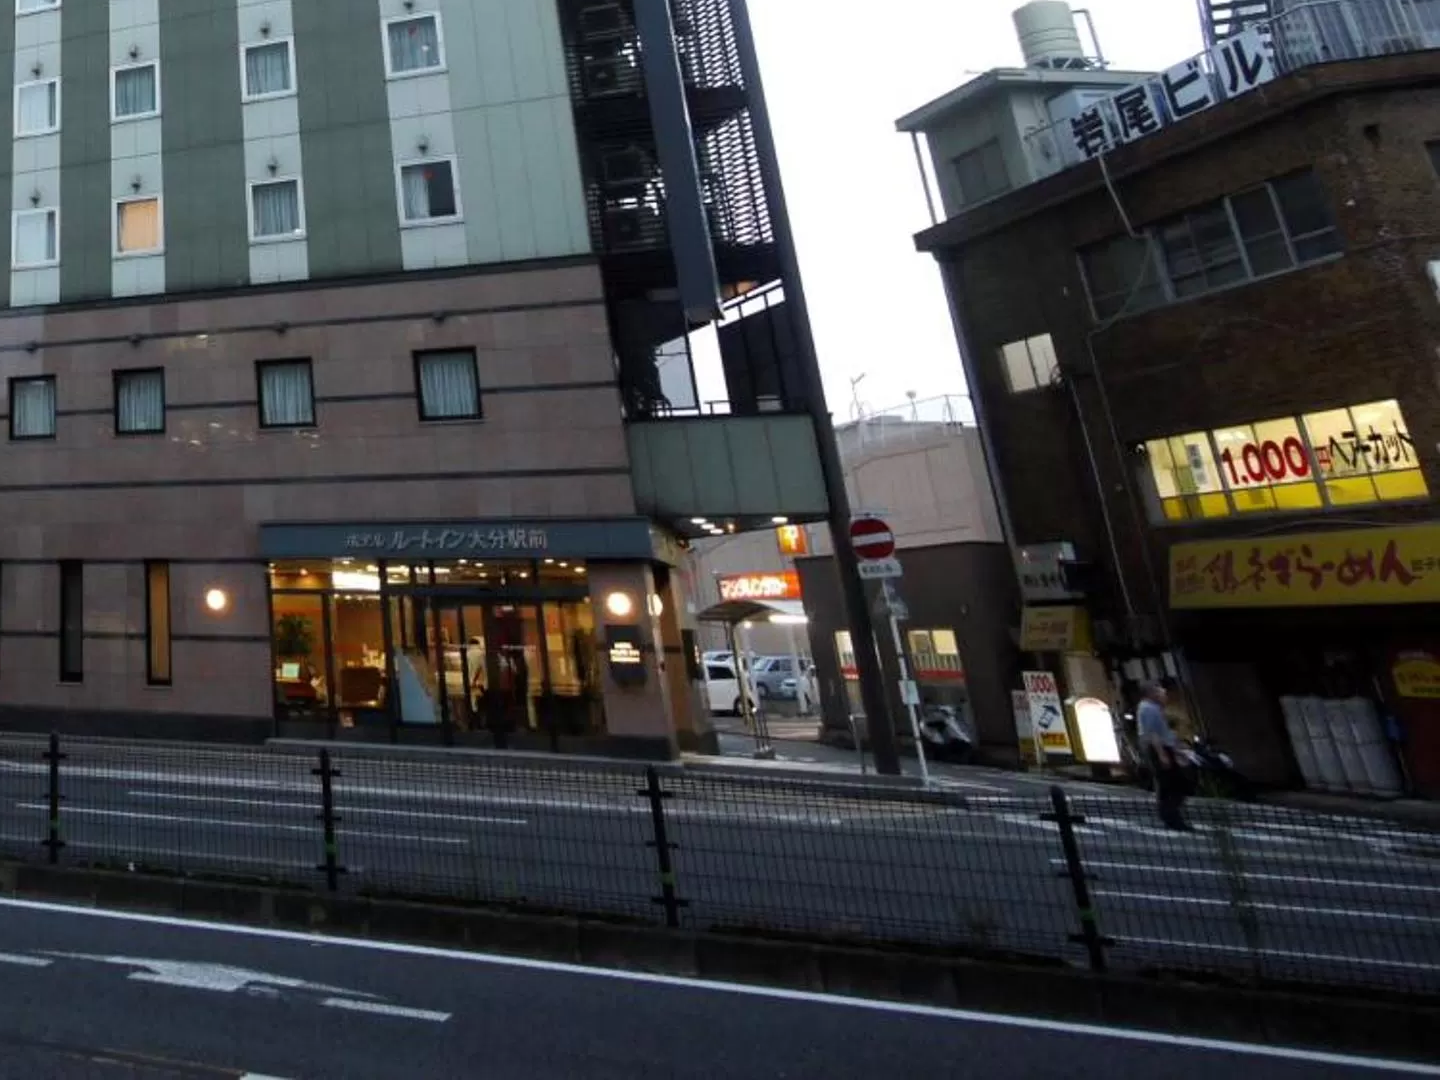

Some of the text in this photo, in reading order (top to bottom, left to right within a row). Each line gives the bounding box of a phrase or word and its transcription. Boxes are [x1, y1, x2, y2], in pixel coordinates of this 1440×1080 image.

[1071, 38, 1264, 160] 岩尾ビル
[390, 525, 548, 550] ルートイン大分駅前
